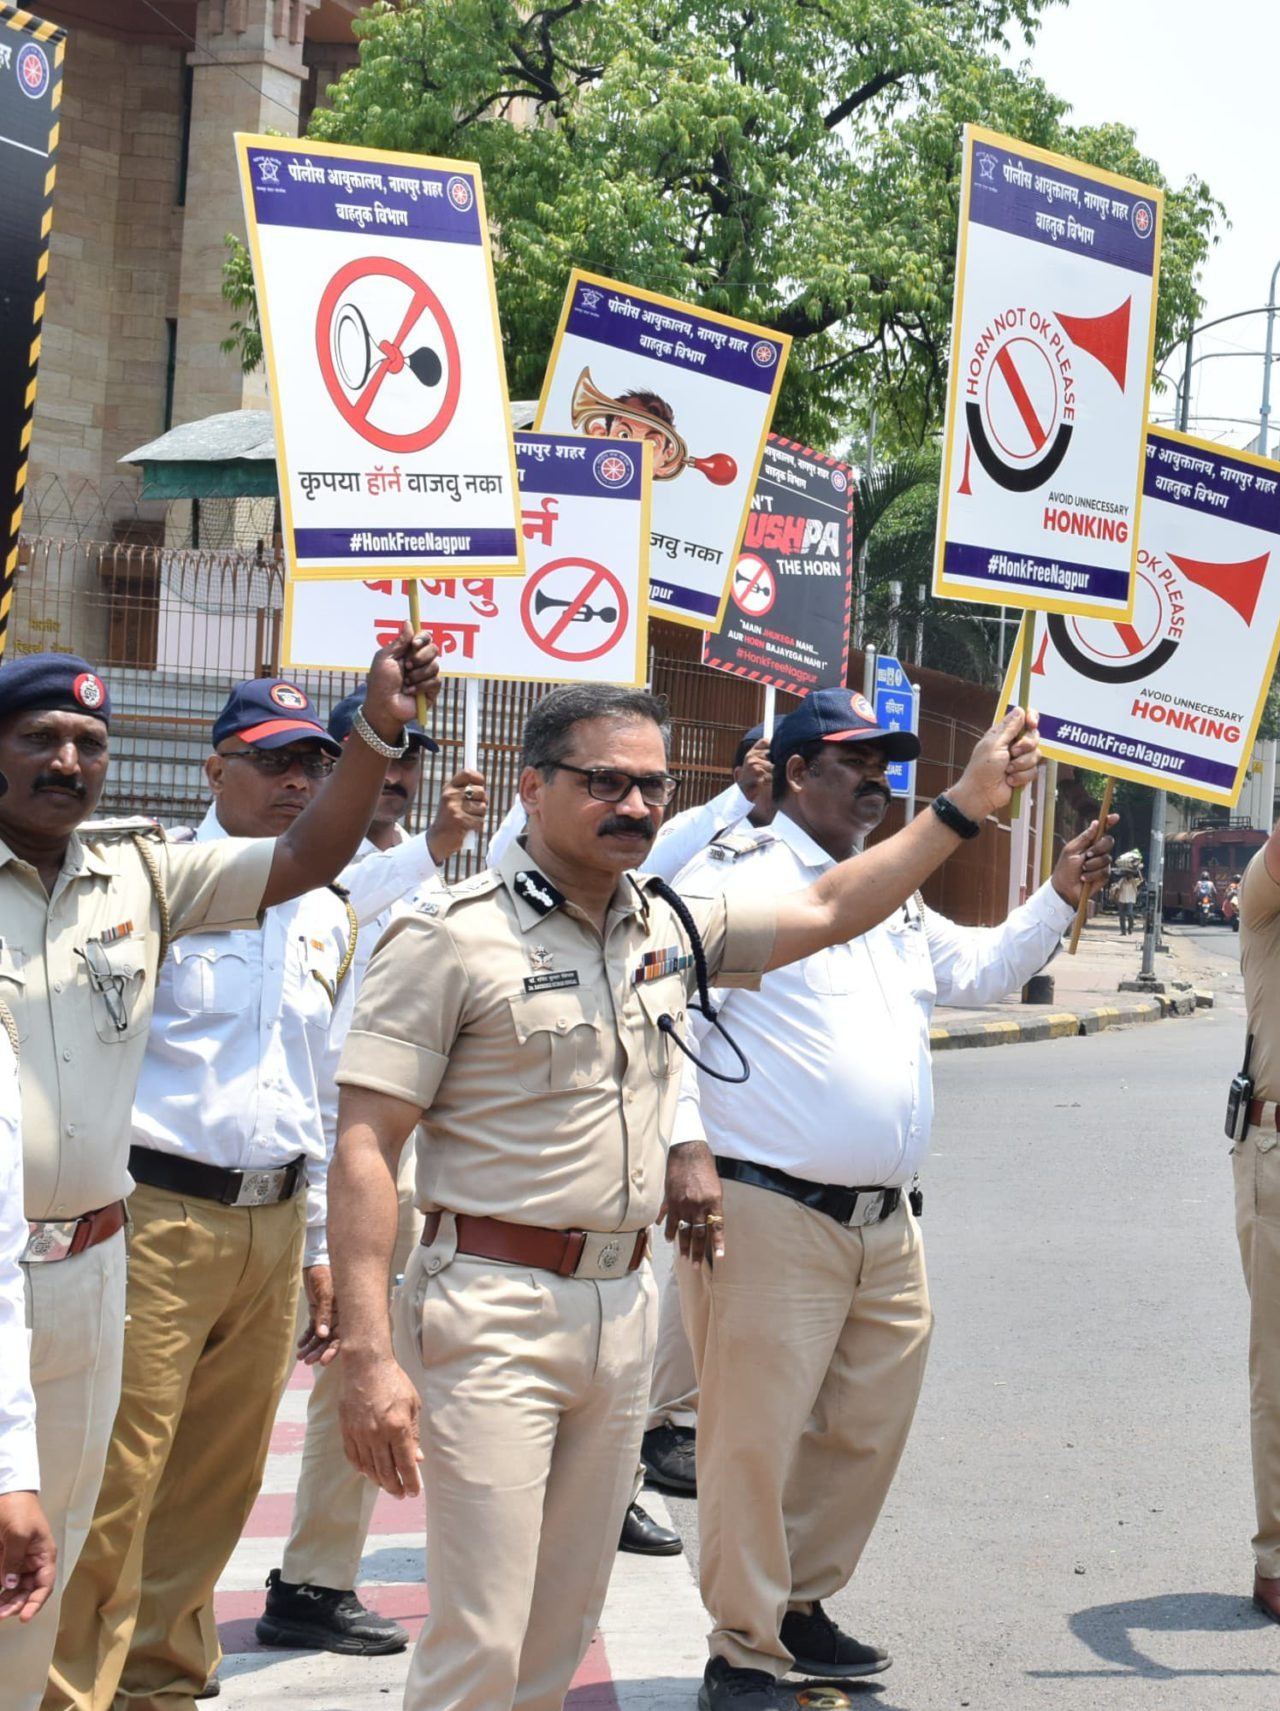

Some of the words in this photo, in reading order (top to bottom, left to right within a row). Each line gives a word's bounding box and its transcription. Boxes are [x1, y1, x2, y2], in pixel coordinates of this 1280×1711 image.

[287, 157, 325, 184] पोलीस
[389, 175, 420, 201] नागपुर
[422, 180, 443, 198] शहर
[1002, 159, 1032, 188] पोलीस
[1083, 191, 1111, 220] नागपुर
[1111, 200, 1129, 221] शहर
[374, 202, 409, 227] विभाग
[1067, 215, 1095, 245] विभाग
[608, 295, 641, 320] पोलीस
[697, 326, 728, 349] नागपुर
[728, 335, 750, 353] शहर
[674, 341, 707, 366] विभाग
[966, 327, 995, 395] HORN
[993, 307, 1026, 336] NOT
[1029, 311, 1052, 340] OK
[1049, 333, 1075, 421] PLEASE
[555, 445, 587, 460] शहर
[298, 471, 361, 500] कृपया
[364, 465, 401, 497] हॉर्न
[406, 473, 462, 502] वाजवु
[463, 474, 504, 496] नका
[1193, 482, 1230, 509] विभाग
[1219, 466, 1254, 492] नागपुर
[1254, 476, 1278, 495] शहर
[751, 493, 774, 512] N'T
[1048, 491, 1074, 506] AVOID
[1074, 495, 1129, 516] UNNECESSARY
[743, 511, 840, 558] USHPA
[1043, 507, 1128, 543] HONKING
[350, 532, 471, 555] #HonkFreeNagpur
[683, 540, 724, 565] नका
[776, 559, 802, 575] THE
[803, 560, 842, 577] HORN
[987, 555, 1090, 591] #HonkFreeNagpur
[1137, 549, 1163, 574] OK
[1158, 568, 1185, 639] PLEASE
[727, 629, 744, 642] AUR
[744, 634, 765, 649] HORN
[765, 642, 804, 663] BAJAYEGA
[736, 647, 818, 683] #HonkFreeNagpur
[1130, 699, 1241, 744] HONKING
[1140, 688, 1172, 703] AVOID
[1173, 696, 1244, 723] UNNECESSARY
[1057, 724, 1185, 771] #HonkFreeNagpur
